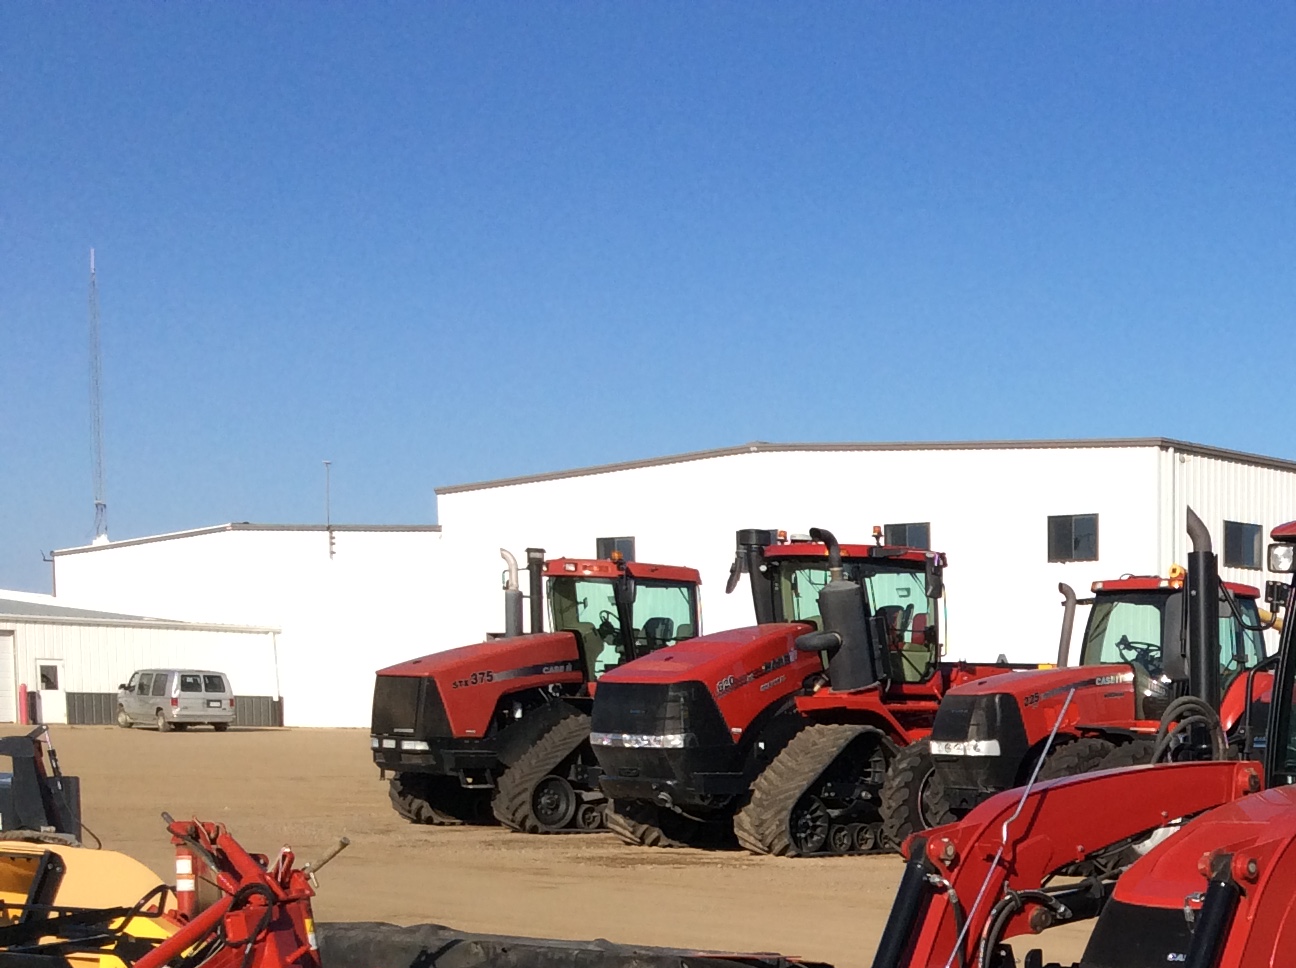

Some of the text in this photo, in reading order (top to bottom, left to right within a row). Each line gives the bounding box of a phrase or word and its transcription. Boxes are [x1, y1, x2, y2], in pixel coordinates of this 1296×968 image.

[452, 670, 494, 689] STX 375
[1095, 675, 1115, 686] CASE
[1024, 692, 1040, 707] 225
